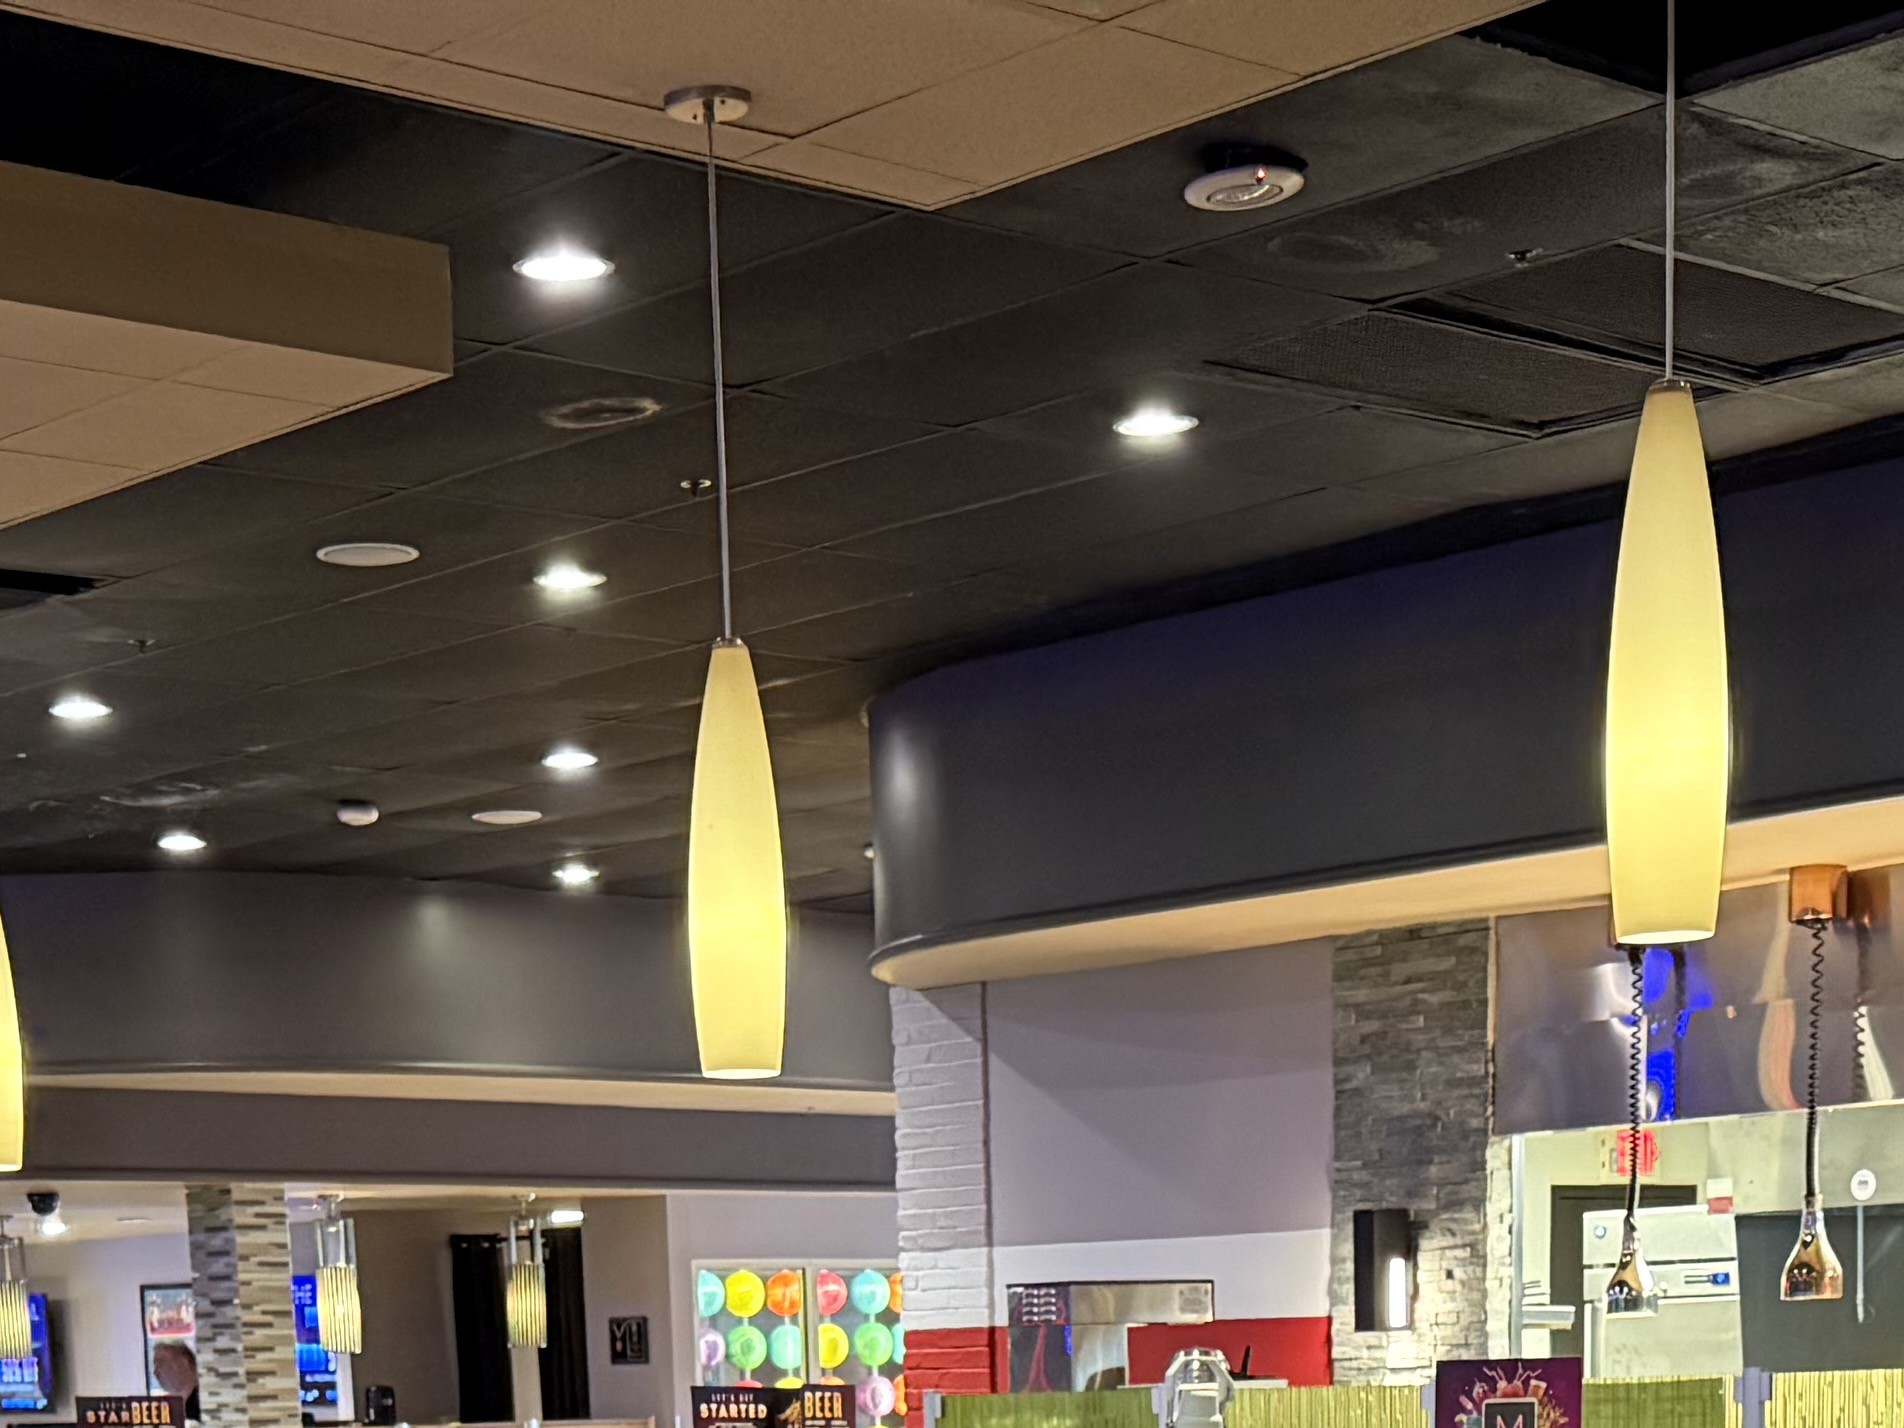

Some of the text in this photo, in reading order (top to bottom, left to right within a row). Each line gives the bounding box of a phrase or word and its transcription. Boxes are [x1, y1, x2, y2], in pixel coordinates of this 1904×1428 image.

[131, 1401, 171, 1424] BEER
[699, 1403, 768, 1419] STARTED
[803, 1391, 843, 1419] BEER
